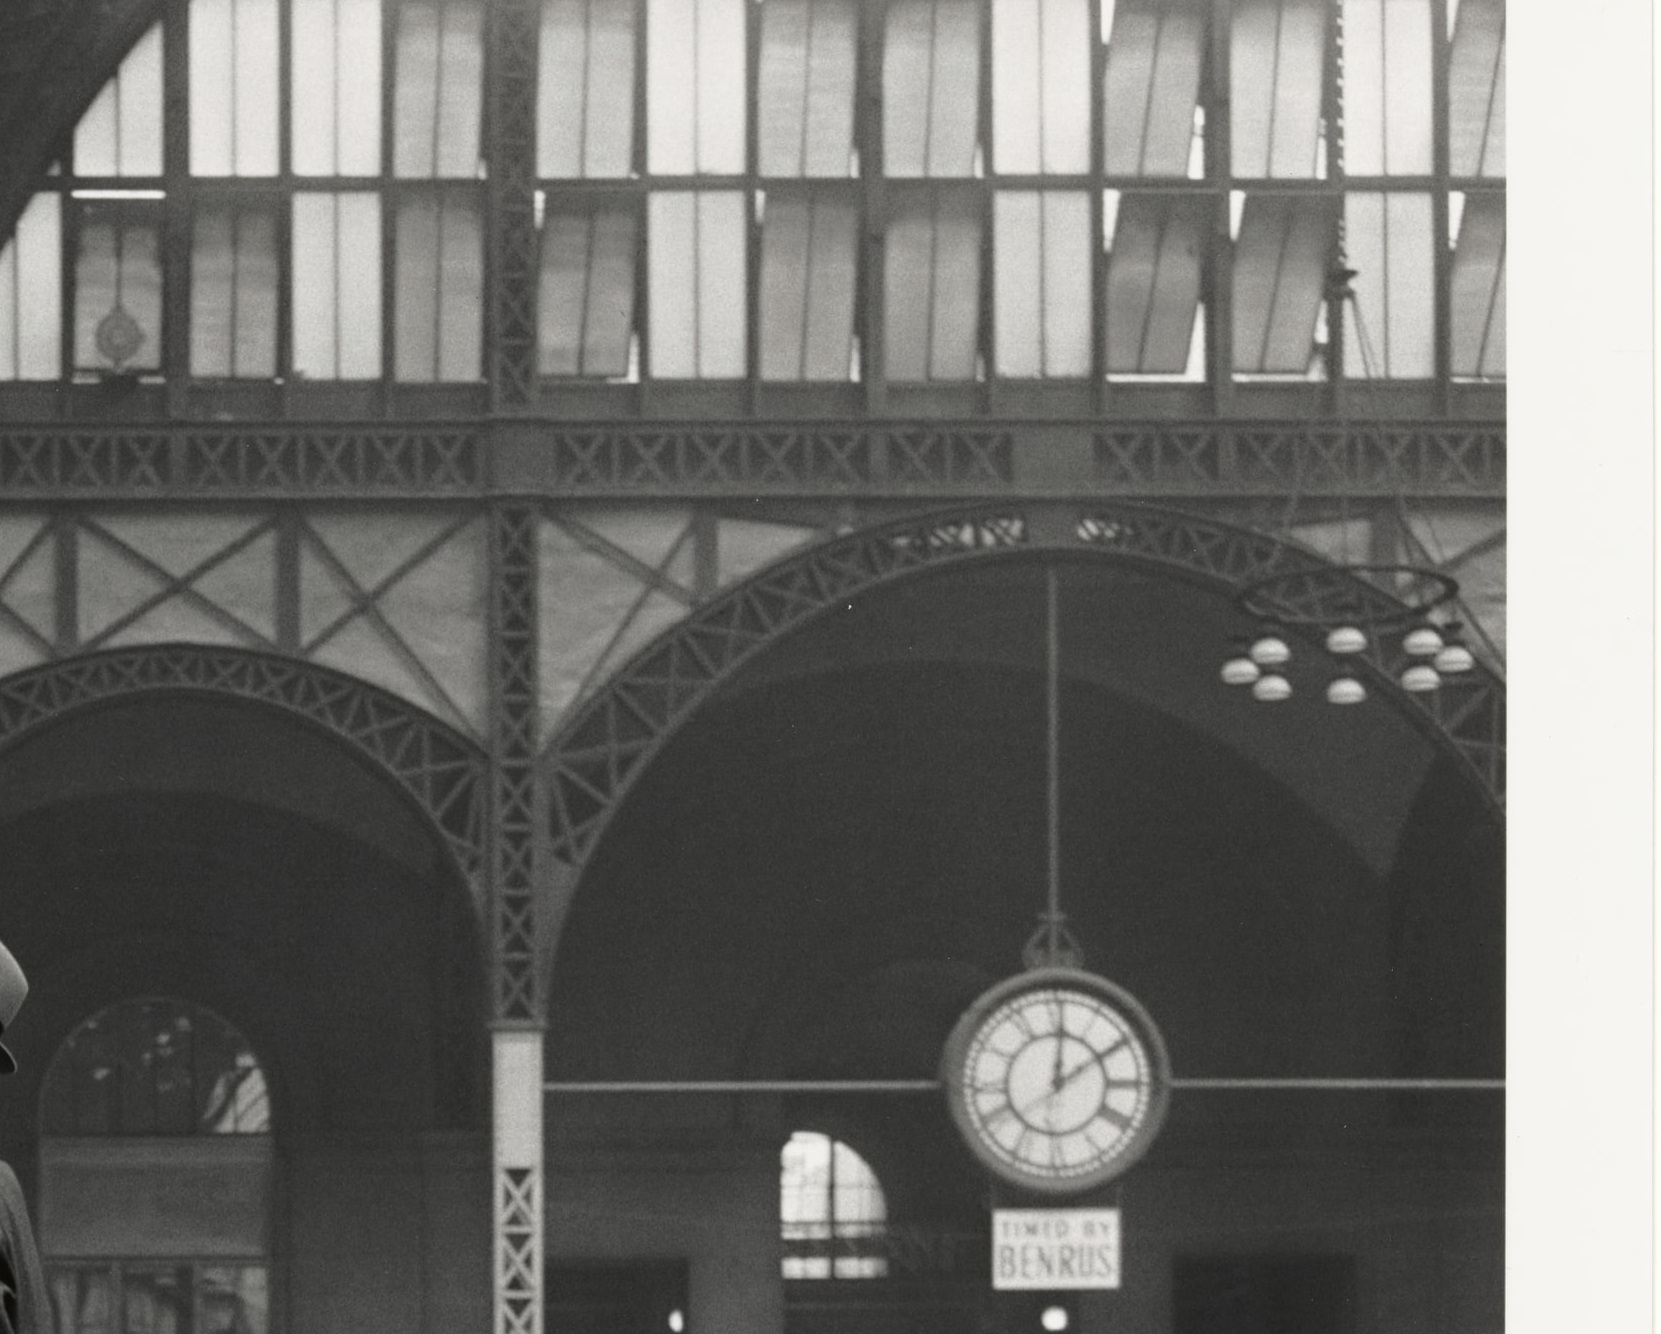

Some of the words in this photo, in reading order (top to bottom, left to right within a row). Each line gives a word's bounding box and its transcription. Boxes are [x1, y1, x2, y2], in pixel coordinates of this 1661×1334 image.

[1001, 1219, 1070, 1239] TIMED
[1082, 1220, 1110, 1238] BY
[999, 1243, 1113, 1279] BENRUS
